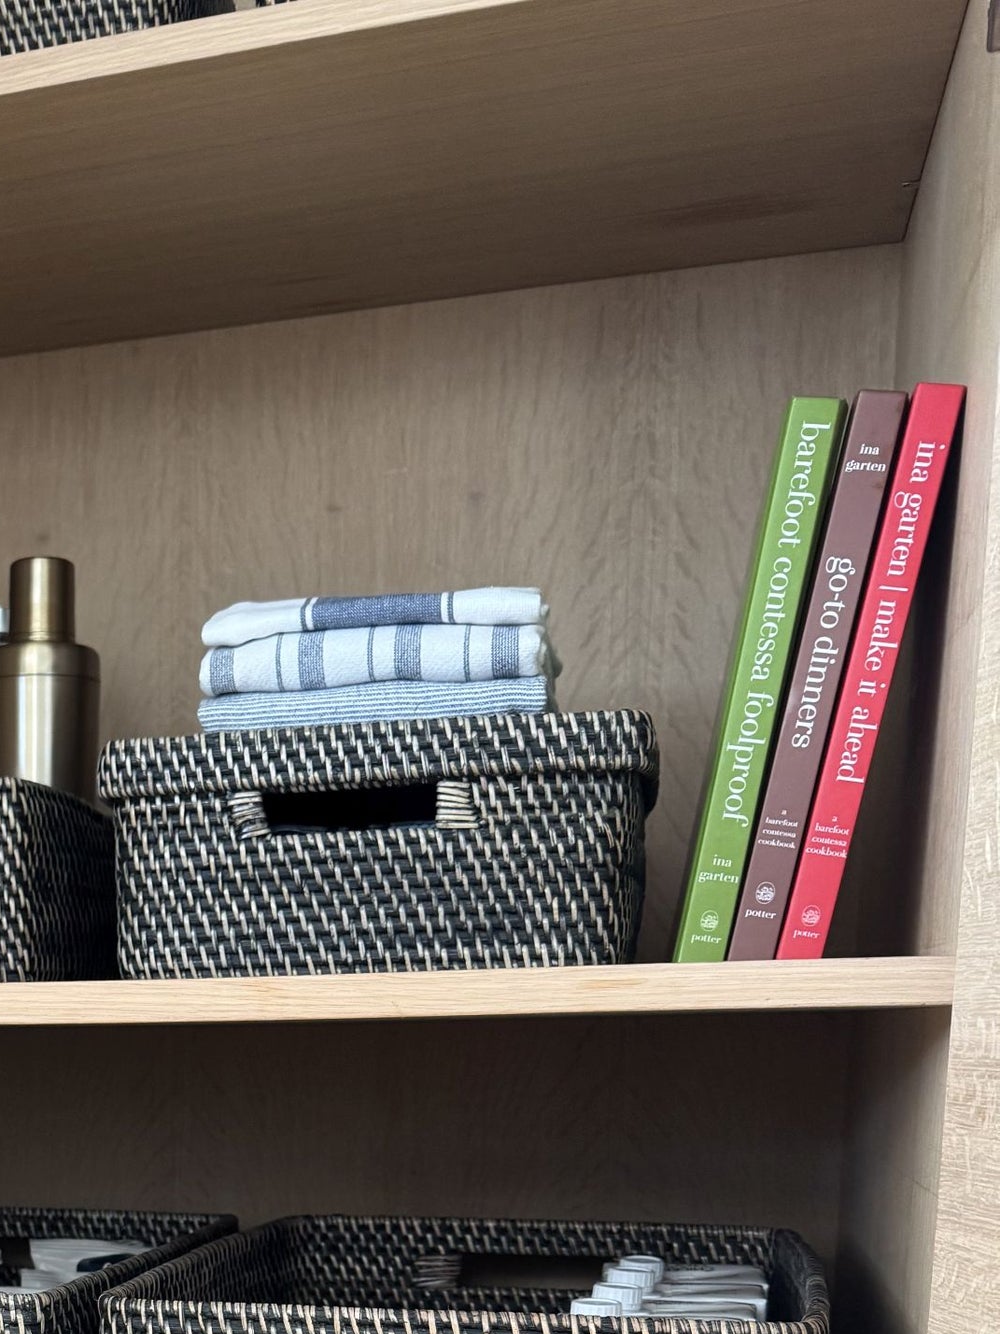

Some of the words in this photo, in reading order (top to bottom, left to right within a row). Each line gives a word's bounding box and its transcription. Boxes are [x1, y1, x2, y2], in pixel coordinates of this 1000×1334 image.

[859, 443, 880, 455] ina
[845, 460, 886, 473] garten
[909, 440, 945, 483] ina
[777, 420, 831, 548] barefoot
[887, 491, 923, 577] garten
[820, 556, 856, 630] go-to
[750, 557, 792, 681] contessa
[864, 600, 898, 672] make
[791, 636, 840, 749] dinners
[858, 683, 887, 697] it
[836, 706, 878, 784] ahead
[722, 691, 775, 828] foolproof
[765, 817, 798, 827] barefoot
[814, 822, 850, 836] barefoot
[762, 828, 796, 838] contessa
[757, 839, 796, 849] cookbook
[811, 836, 847, 847] contessa
[805, 847, 848, 859] cookbook
[712, 854, 732, 868] ina
[698, 871, 739, 884] garten
[744, 908, 777, 919] potter
[690, 933, 722, 944] potter
[793, 929, 820, 939] potter
